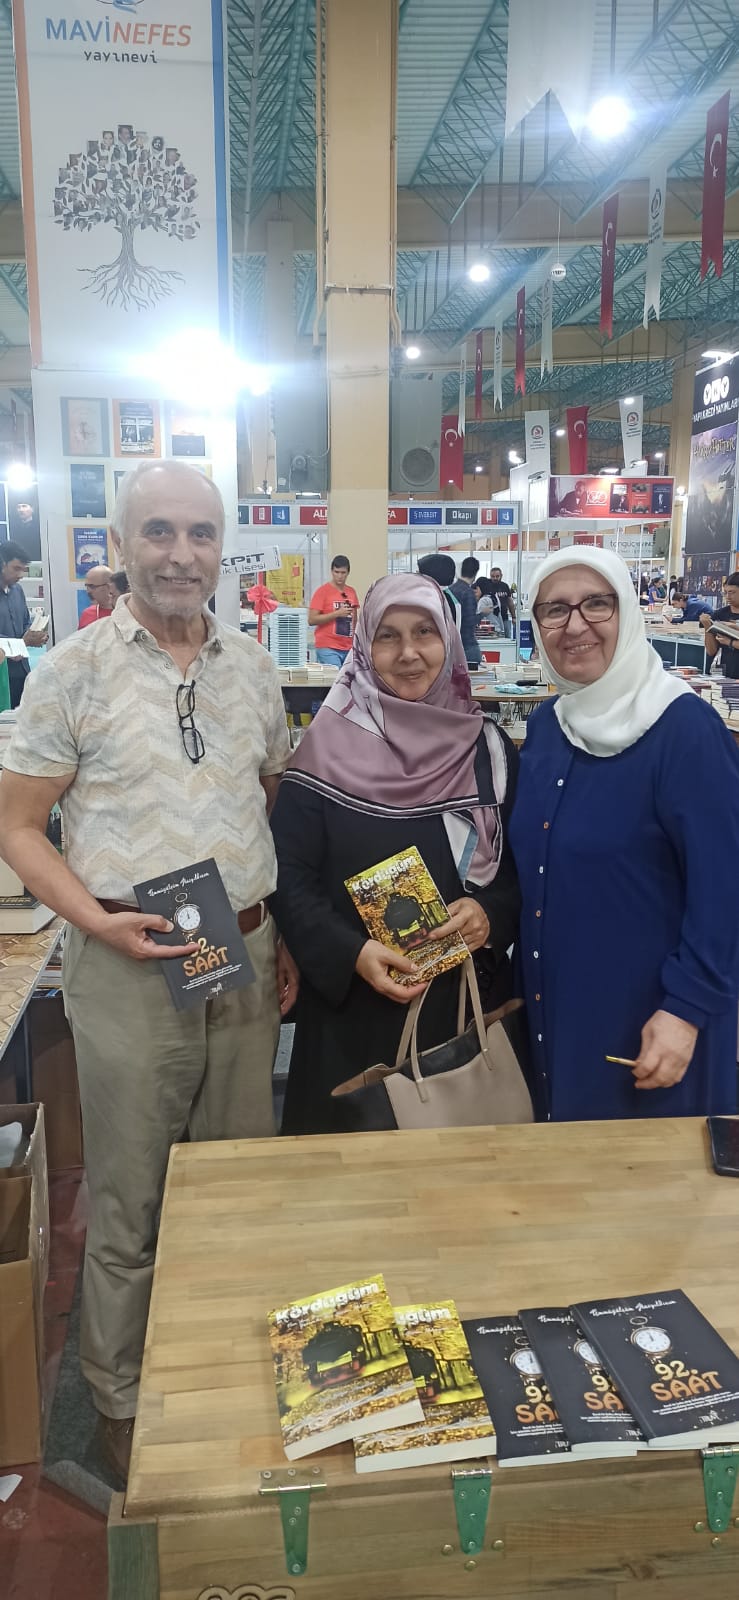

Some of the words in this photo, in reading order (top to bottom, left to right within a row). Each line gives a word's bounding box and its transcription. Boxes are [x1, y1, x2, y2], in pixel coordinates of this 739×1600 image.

[46, 16, 192, 46] MAVİNEFES
[183, 946, 229, 977] SAAT
[655, 1360, 698, 1381] 92.
[650, 1371, 723, 1402] SAAT
